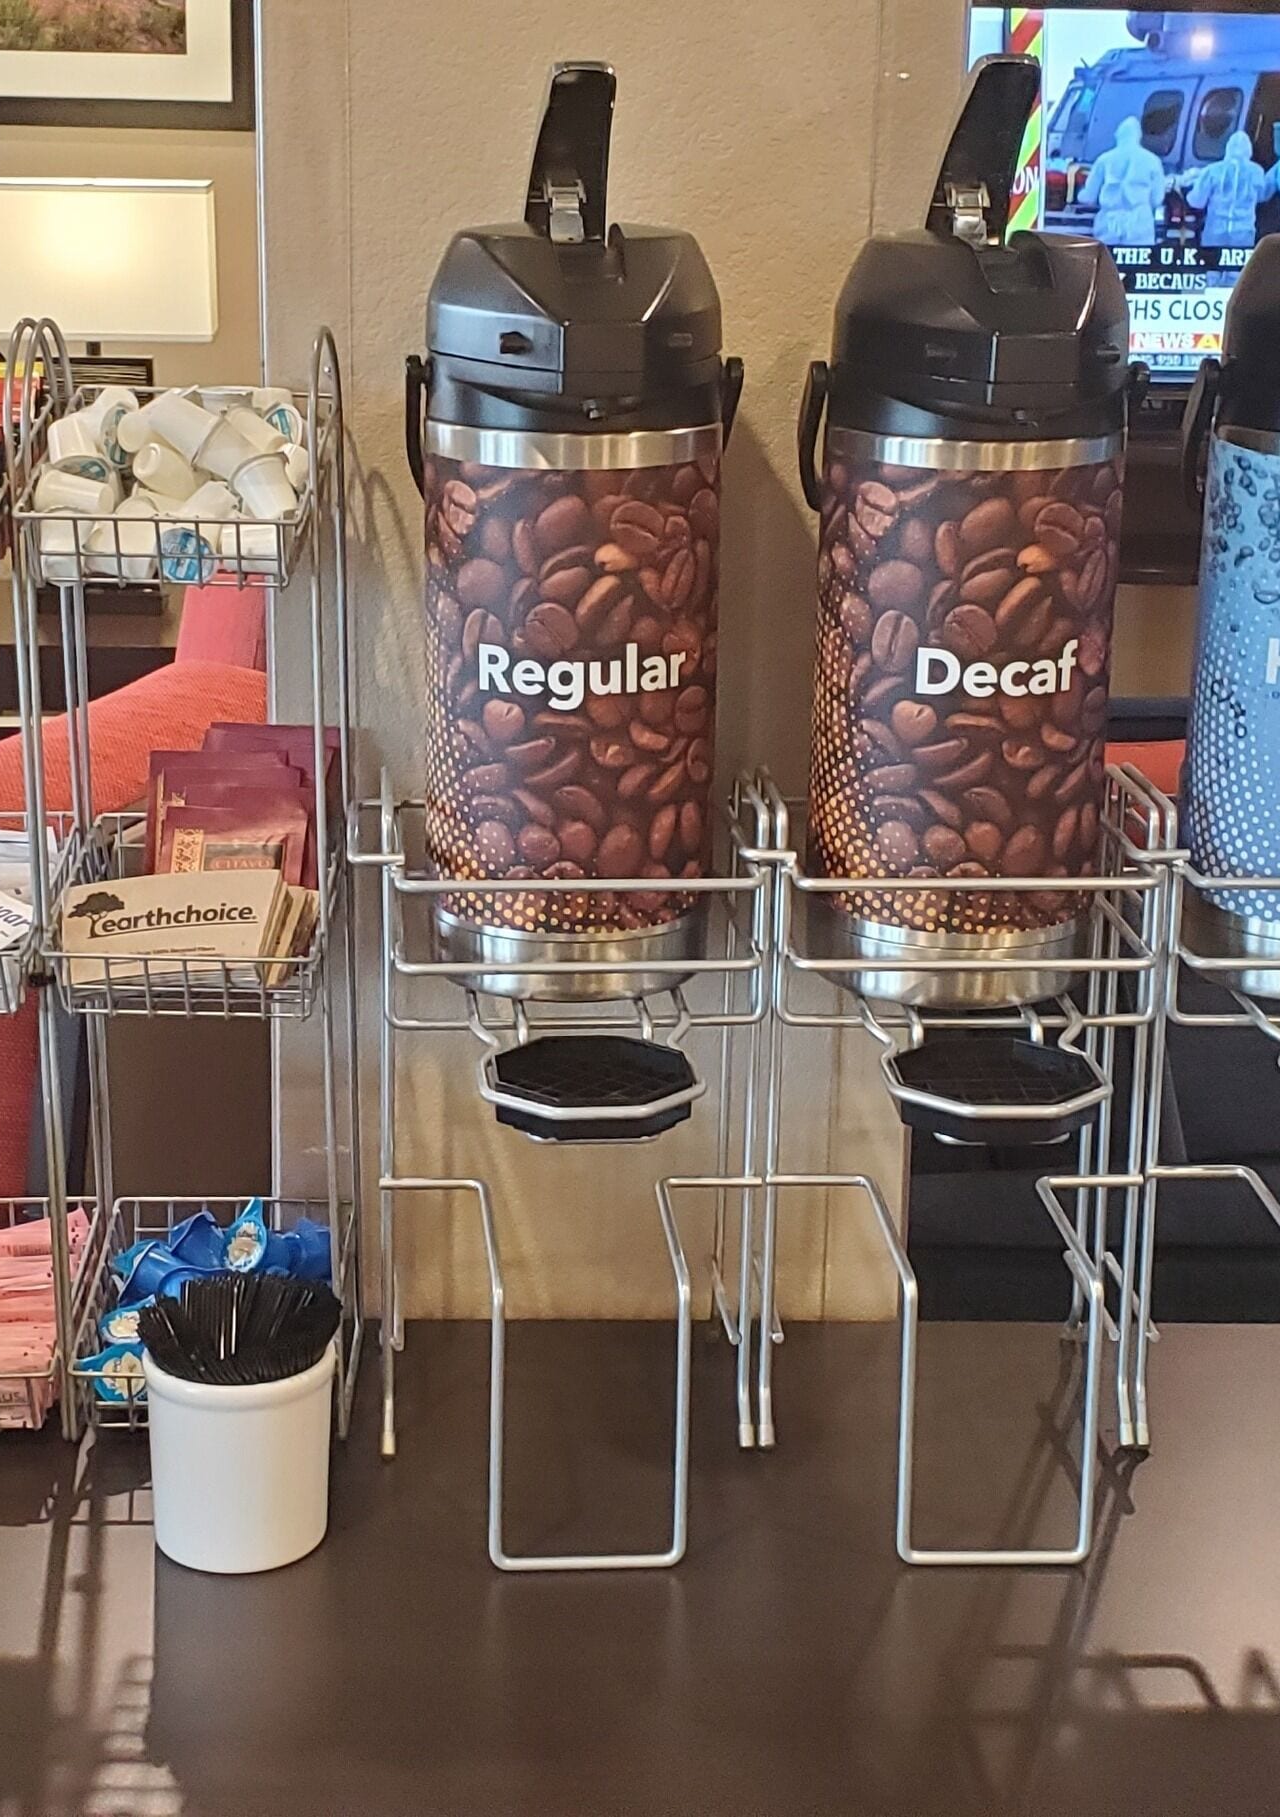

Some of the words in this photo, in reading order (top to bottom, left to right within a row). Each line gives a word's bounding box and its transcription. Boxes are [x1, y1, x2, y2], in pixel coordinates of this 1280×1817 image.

[1113, 247, 1152, 265] THE
[1134, 272, 1207, 290] BECAUS
[1127, 299, 1161, 320] HS
[1131, 332, 1194, 349] NEWS
[478, 642, 687, 712] Regular
[915, 639, 1079, 698] Decaf
